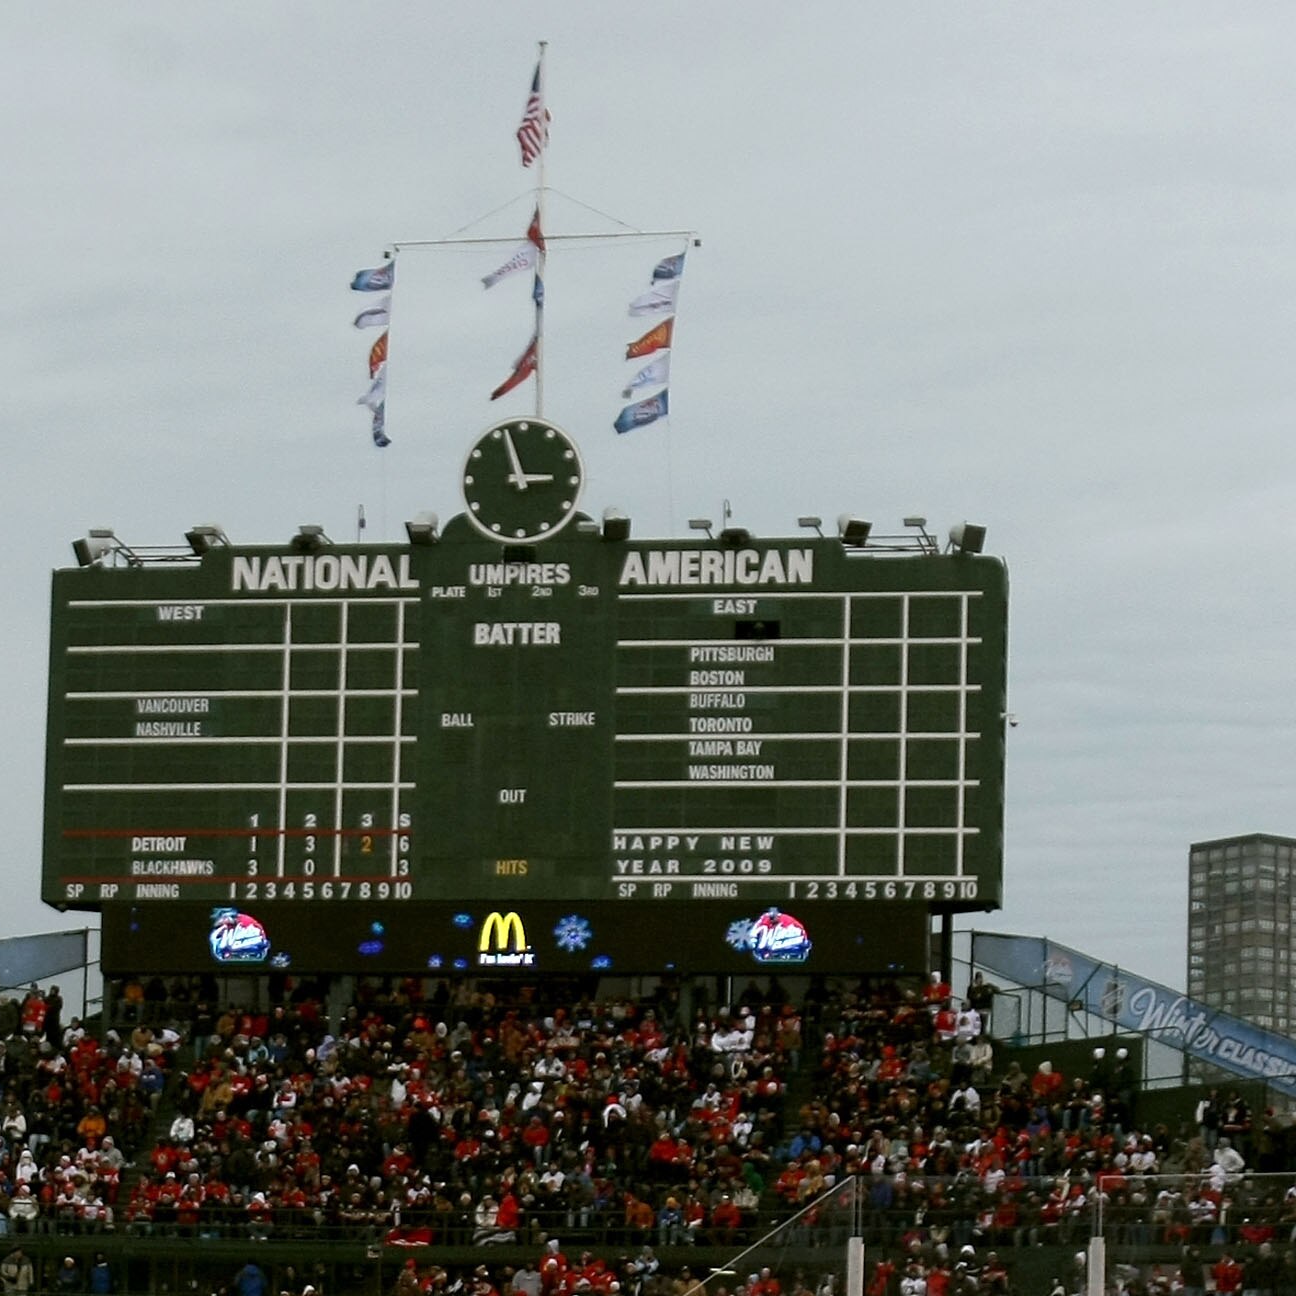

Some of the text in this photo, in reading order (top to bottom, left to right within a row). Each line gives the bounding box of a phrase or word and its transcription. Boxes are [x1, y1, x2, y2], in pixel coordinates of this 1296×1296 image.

[232, 554, 420, 591] NATIONAL
[469, 564, 570, 585] UMPIRES
[619, 549, 814, 585] AMERICAN
[432, 586, 465, 597] PLATE
[532, 586, 552, 597] 2ND
[578, 585, 599, 596] 3RD
[158, 606, 204, 621] WEST
[713, 600, 757, 614] EAST
[474, 622, 560, 645] BATTER
[690, 648, 774, 662] PITTSBURGH
[689, 671, 744, 685] BOSTON
[137, 698, 209, 714] VANCOUVER
[689, 694, 745, 708] BUFFALO
[442, 714, 473, 727] BALL
[549, 712, 595, 726] STRIKE
[689, 717, 752, 732] TORONTO
[136, 722, 201, 737] NASHVILLE
[689, 741, 762, 756] TAMPA BAY
[689, 765, 774, 779] WASHINGTON
[500, 789, 526, 803] OUT
[250, 814, 259, 827] 1
[305, 814, 316, 827] 2
[362, 814, 372, 827] 3
[132, 836, 409, 853] DETROIT 1 3 2 6
[614, 836, 775, 850] HAPPY NEW
[132, 860, 409, 876] BLACKHAWKS 3 0 3
[496, 861, 528, 875] HITS
[617, 860, 772, 873] YEAR 2009
[66, 883, 84, 899] SP
[100, 883, 118, 899] RP
[136, 883, 179, 899] INNING
[246, 883, 258, 899] 2
[266, 883, 276, 899] 3
[284, 883, 295, 899] 4
[303, 883, 314, 899] 5
[322, 883, 333, 899] 6
[341, 883, 351, 899] 7
[359, 883, 371, 899] 8
[378, 883, 390, 899] 9
[395, 883, 412, 899] 10
[619, 883, 636, 898] SP
[654, 883, 672, 898] RP
[693, 883, 738, 898] INNING
[807, 883, 818, 898] 2
[827, 883, 837, 898] 3
[845, 883, 857, 898] 4
[865, 883, 876, 898] 5
[885, 883, 896, 898] 6
[904, 883, 915, 898] 7
[924, 883, 935, 898] 8
[944, 883, 955, 898] 9
[960, 883, 978, 898] 10
[1130, 987, 1219, 1051] Winter
